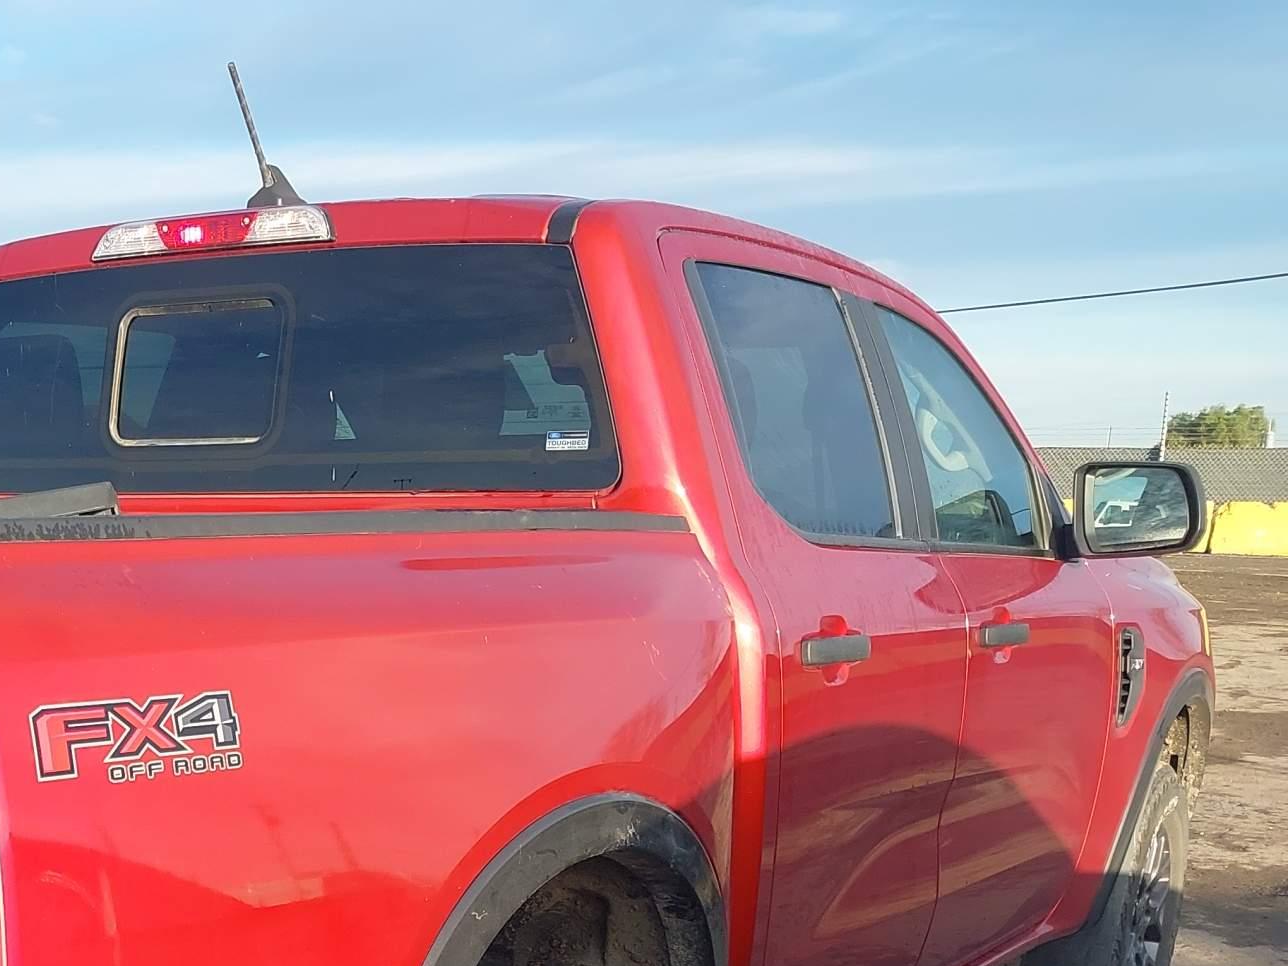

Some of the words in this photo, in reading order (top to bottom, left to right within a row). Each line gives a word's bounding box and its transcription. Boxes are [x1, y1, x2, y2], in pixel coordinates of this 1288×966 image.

[547, 439, 587, 447] TOUGHBED
[28, 690, 241, 783] FX4
[108, 759, 165, 783] OFF
[172, 752, 243, 777] ROAD
